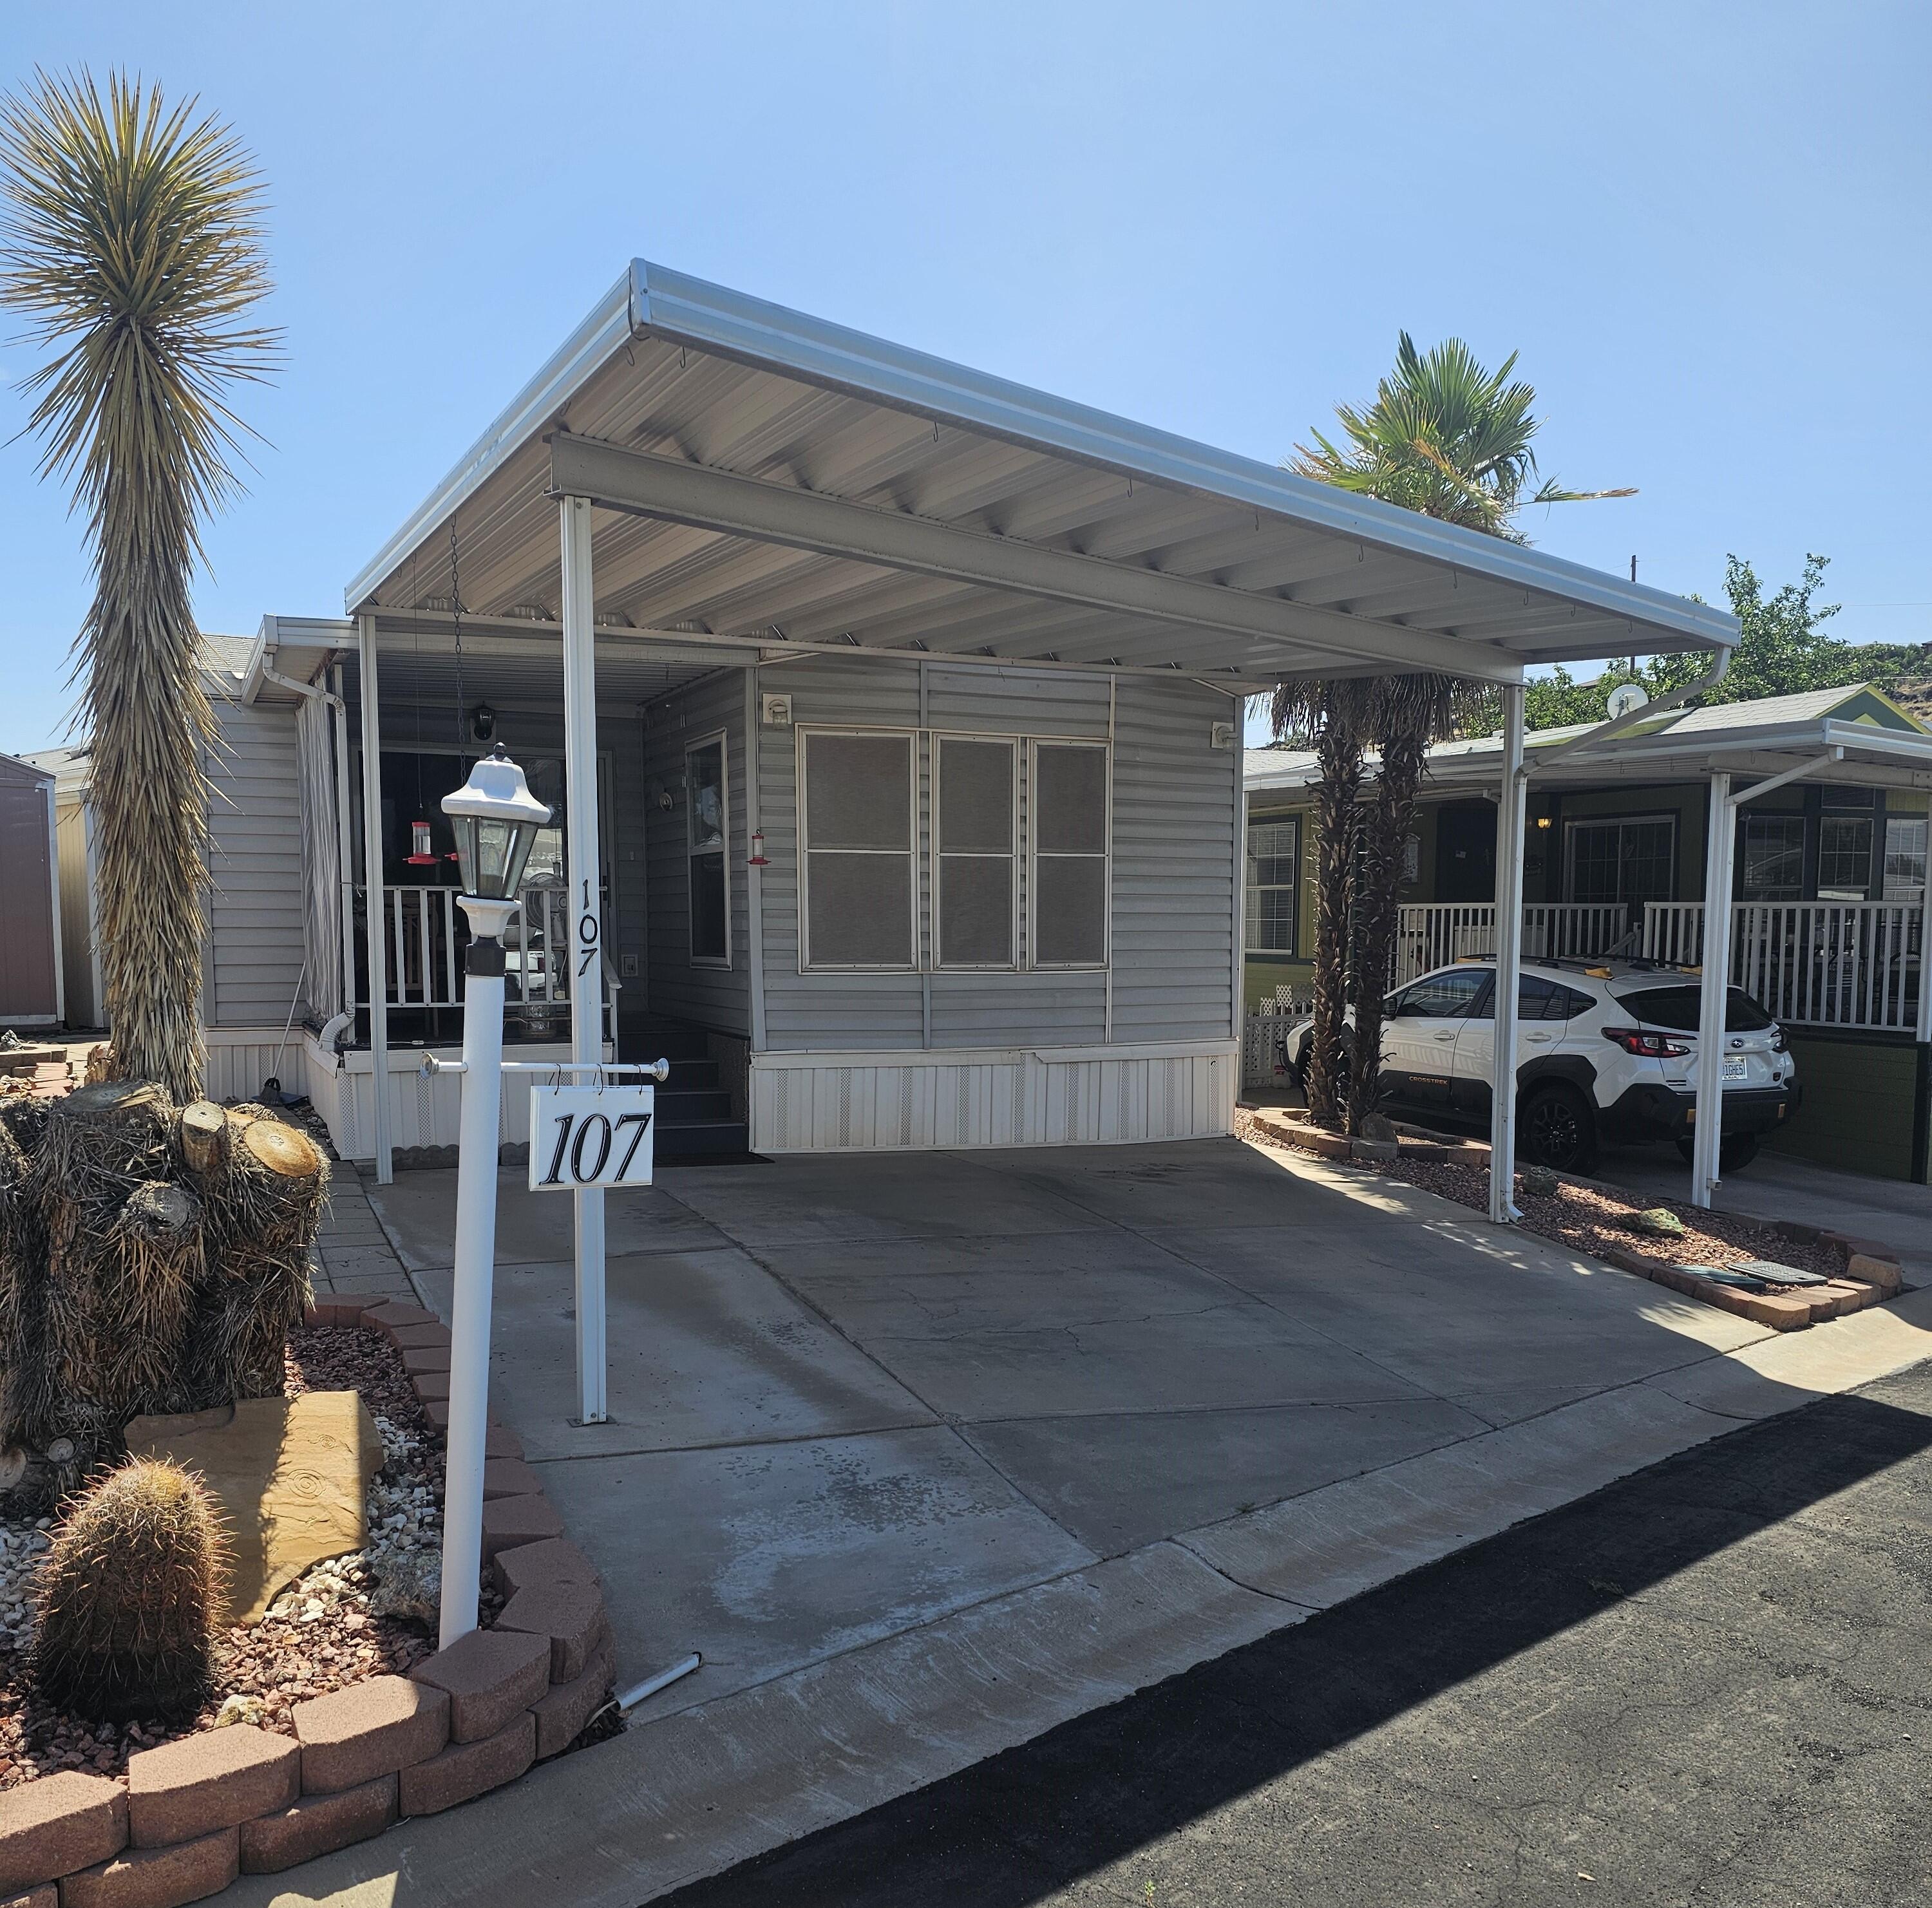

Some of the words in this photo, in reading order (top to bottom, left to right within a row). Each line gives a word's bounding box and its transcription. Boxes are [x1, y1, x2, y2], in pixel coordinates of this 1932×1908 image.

[578, 879, 598, 977] 107
[1409, 1076, 1448, 1085] CROSSTREK
[539, 1113, 652, 1185] 107
